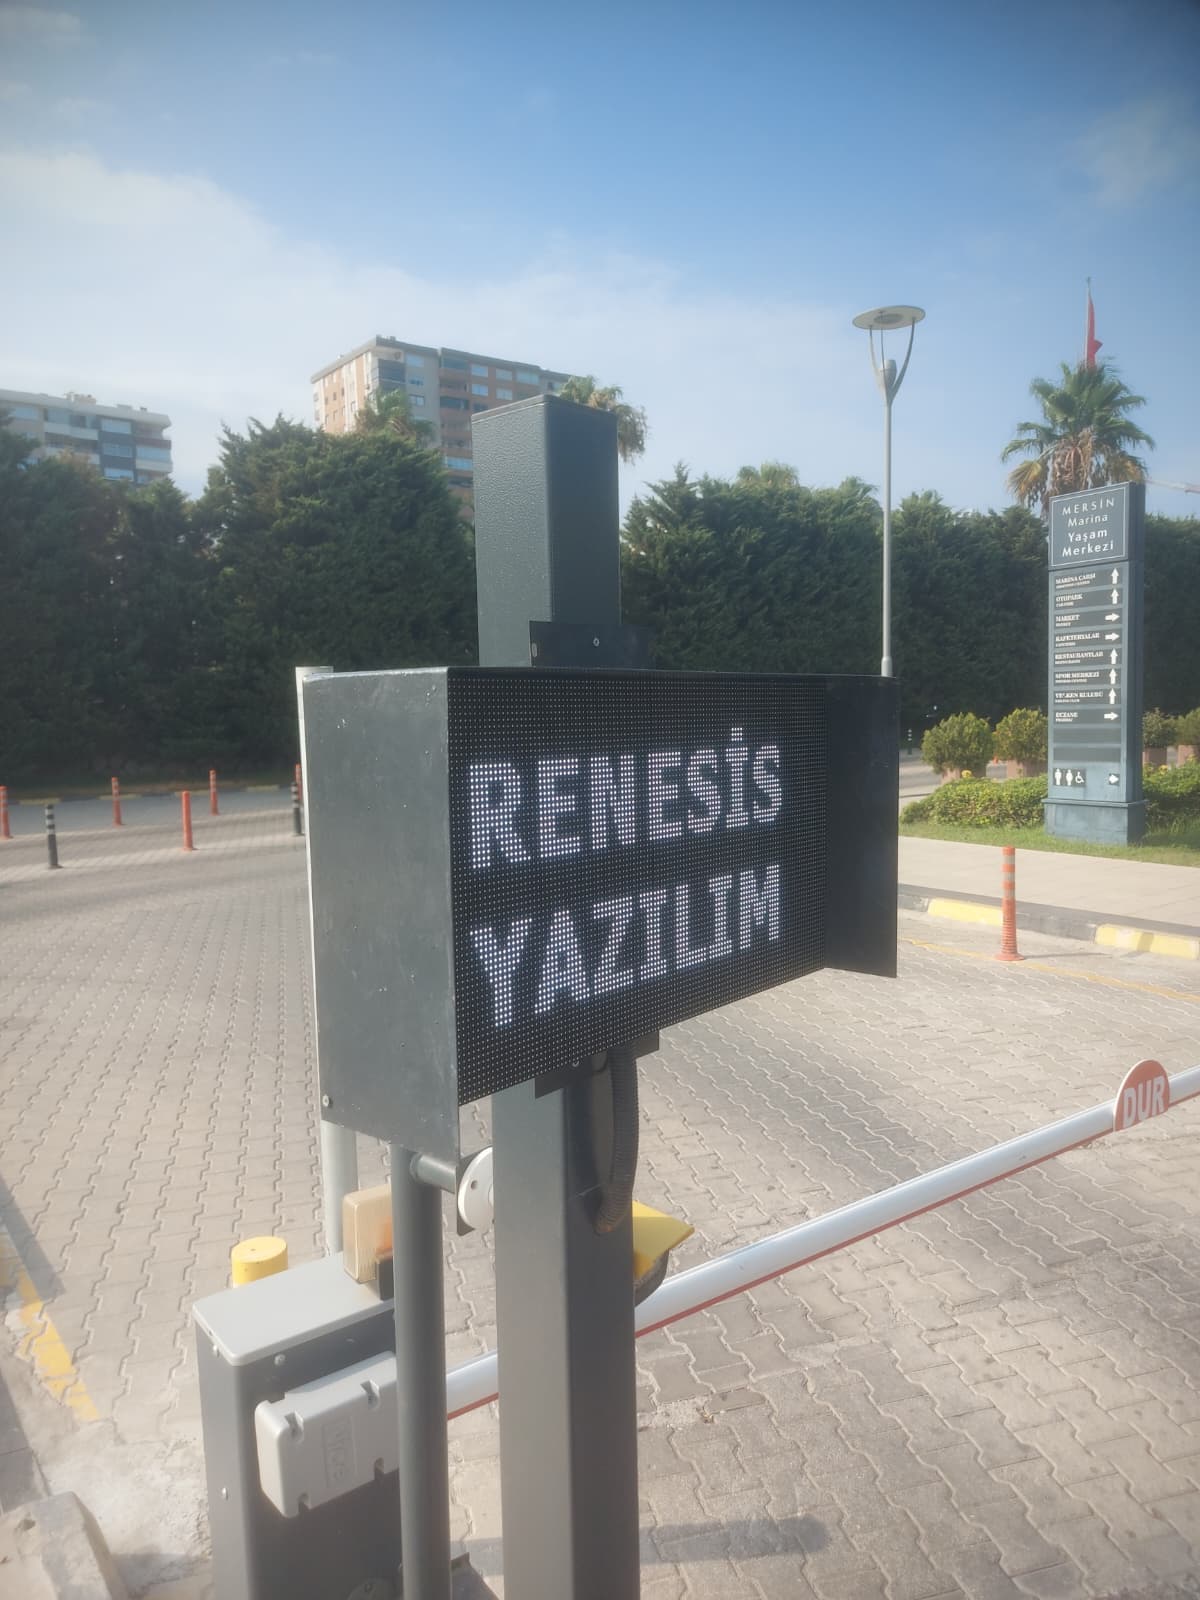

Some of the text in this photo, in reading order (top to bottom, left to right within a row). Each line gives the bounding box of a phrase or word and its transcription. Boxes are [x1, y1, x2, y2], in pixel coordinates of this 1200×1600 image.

[1067, 514, 1109, 528] Marina
[1067, 529, 1108, 543] Yaşam
[1062, 540, 1114, 558] Merkezi
[470, 727, 782, 869] RENESİS
[469, 864, 781, 1027] YAZILIM
[1123, 1075, 1166, 1128] DUR
